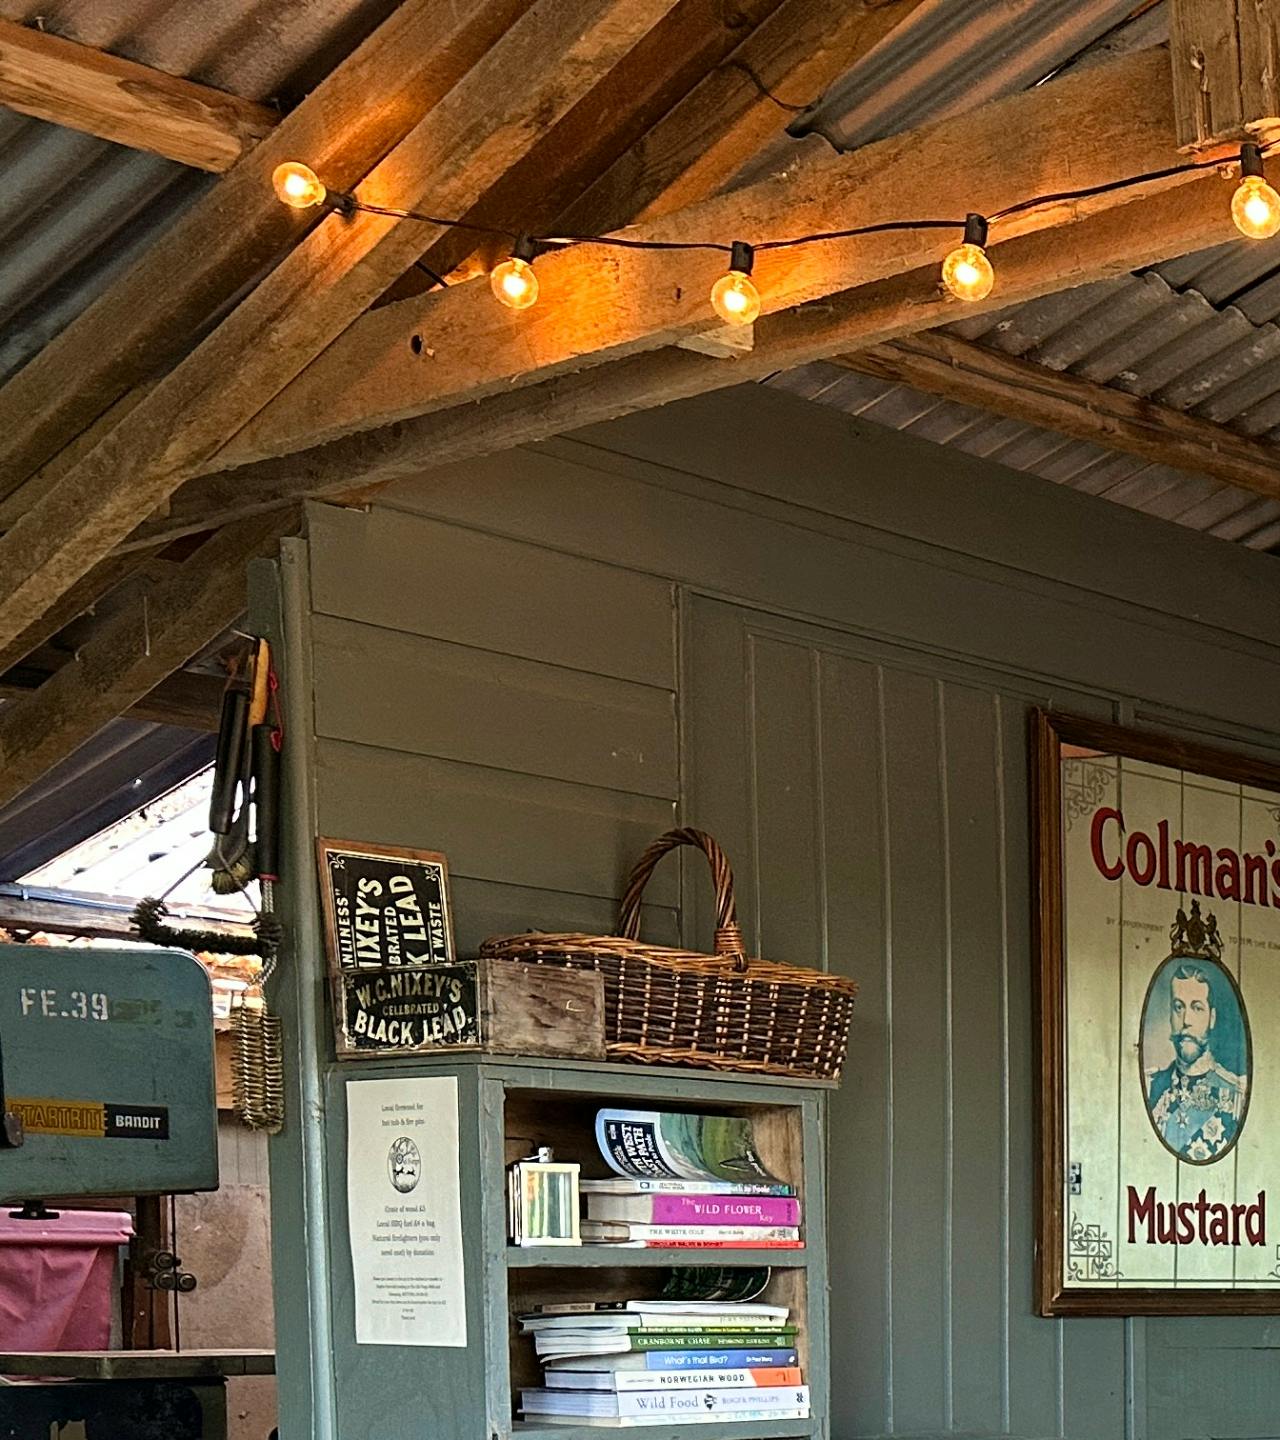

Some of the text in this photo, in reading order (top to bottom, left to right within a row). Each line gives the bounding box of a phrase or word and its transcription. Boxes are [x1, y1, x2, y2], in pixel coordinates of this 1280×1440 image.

[390, 875, 428, 941] LEAD
[335, 888, 353, 967] NLINESS"
[428, 902, 443, 950] WASTE
[20, 988, 109, 1021] FE.39
[382, 1003, 439, 1016] CELEBRATED
[354, 1008, 414, 1045] BLACK
[115, 1115, 161, 1129] BANDIT
[681, 1197, 695, 1206] The
[693, 1203, 762, 1216] WILD FLOWER
[759, 1214, 775, 1224] Key
[664, 1355, 691, 1365] What's
[660, 1375, 714, 1384] NORWEGIAN
[718, 1373, 745, 1383] WOOD
[636, 1396, 667, 1409] Wild
[670, 1395, 699, 1408] Food
